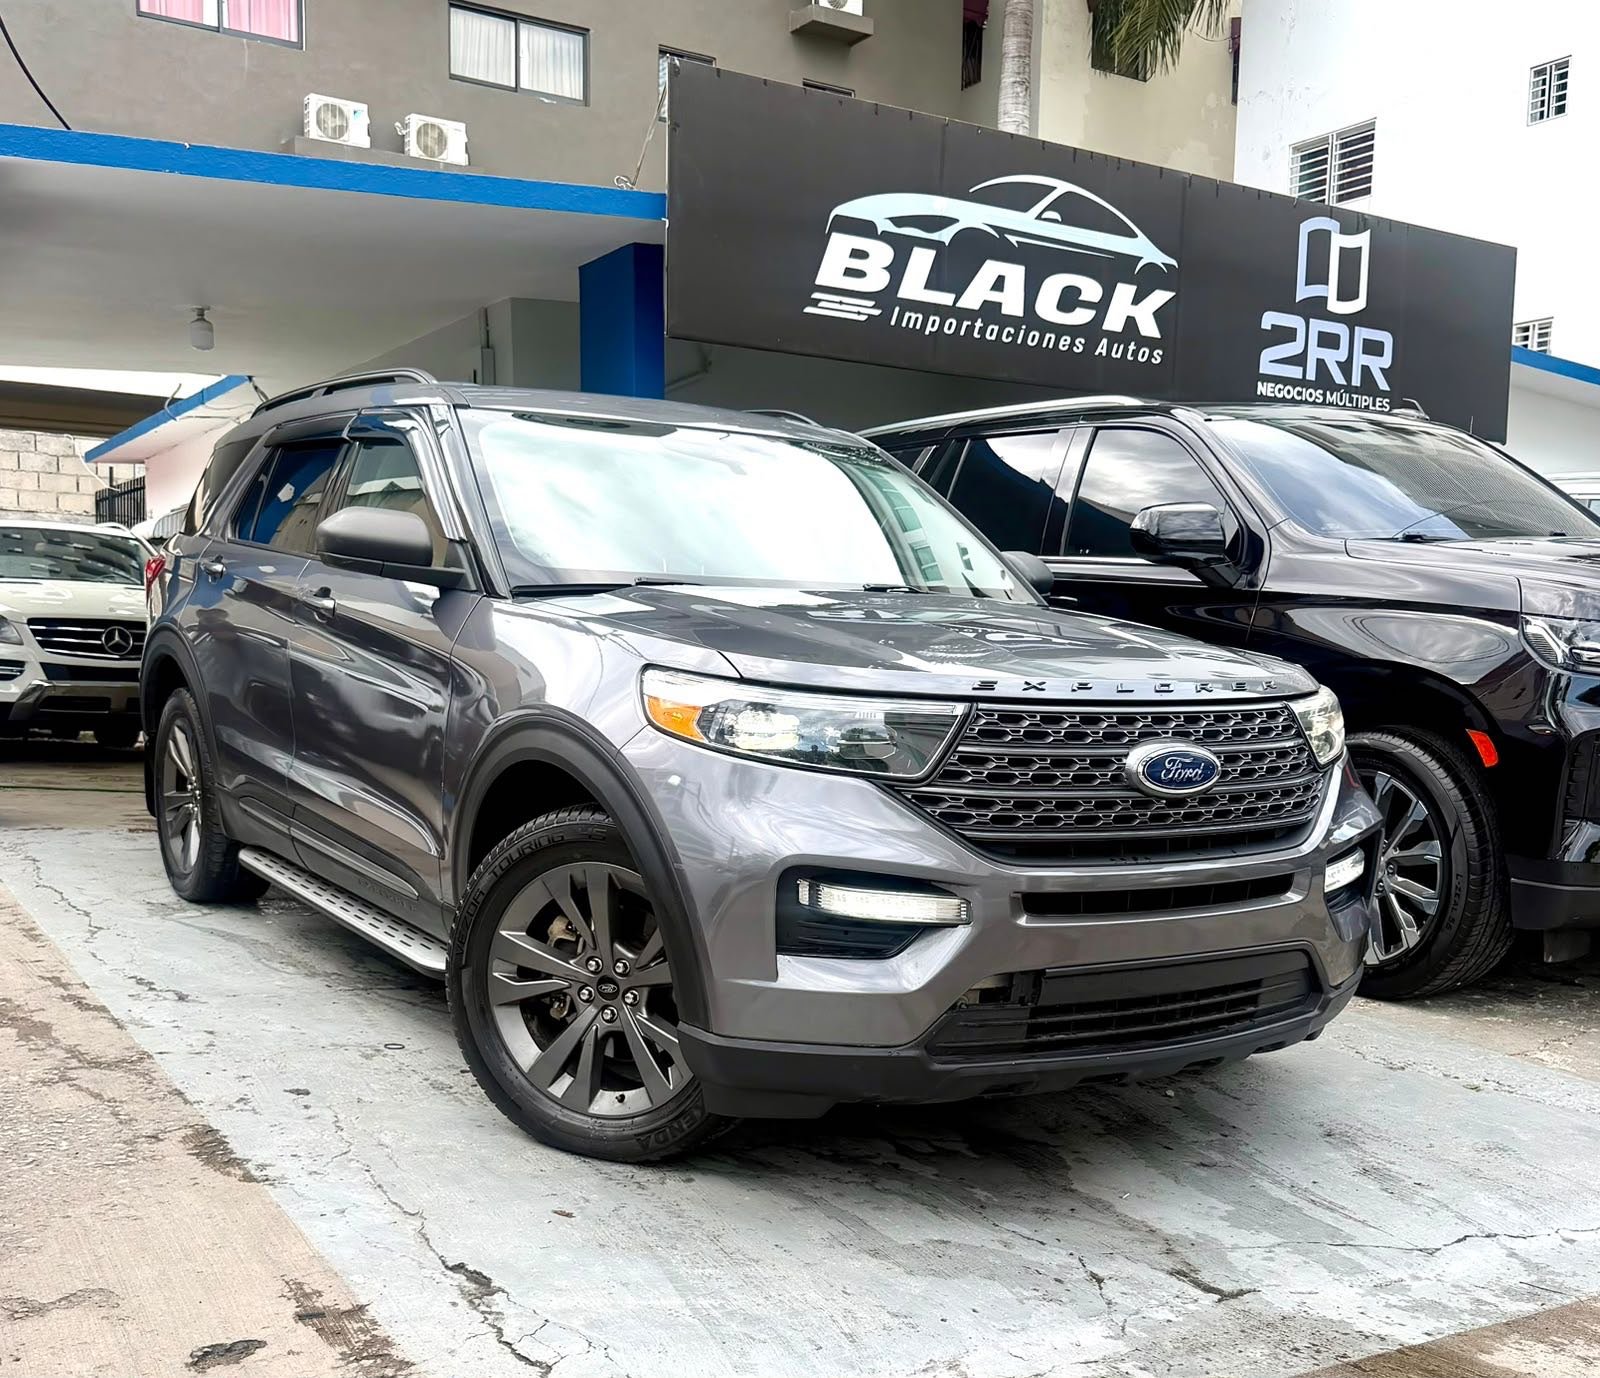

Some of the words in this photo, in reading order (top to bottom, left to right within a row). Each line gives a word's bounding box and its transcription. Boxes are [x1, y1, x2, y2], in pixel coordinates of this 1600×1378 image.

[814, 232, 1177, 339] BLACK
[890, 305, 1086, 353] Importaciones
[1094, 337, 1164, 364] Autos
[1258, 310, 1394, 392] 2RR
[1256, 381, 1324, 404] NEGOCIOS
[1325, 389, 1391, 412] MÚLTIPLES
[971, 679, 1278, 694] EXPLORER
[1160, 756, 1205, 782] Ford
[488, 830, 566, 879] TOURING
